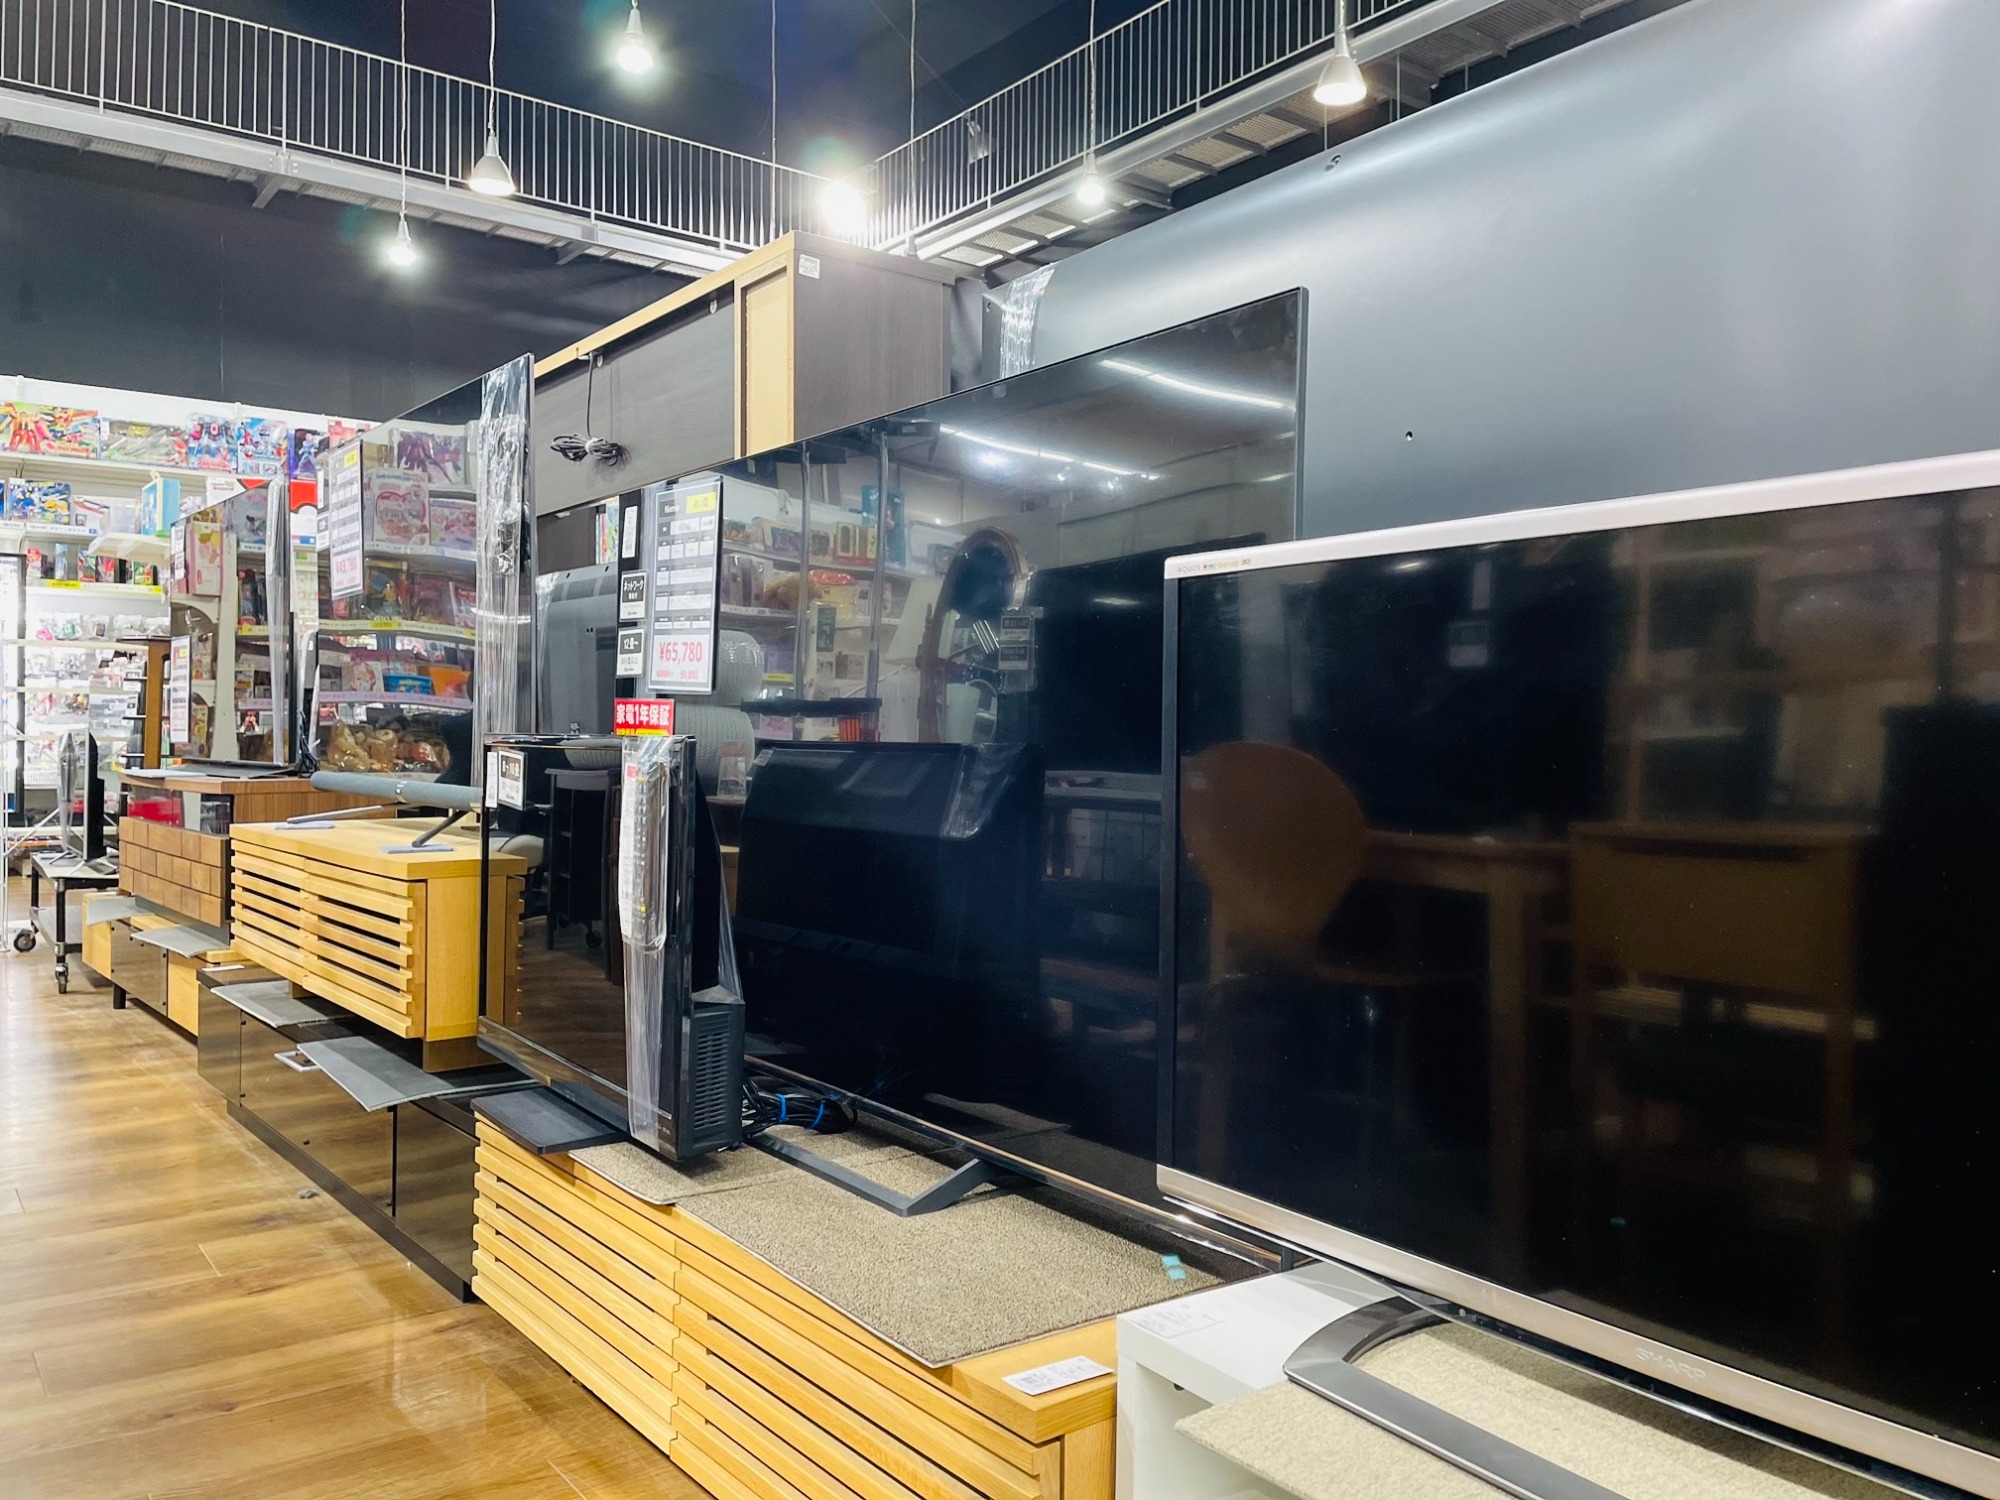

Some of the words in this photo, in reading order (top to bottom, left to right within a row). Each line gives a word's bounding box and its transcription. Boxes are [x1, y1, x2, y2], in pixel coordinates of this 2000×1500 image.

[1178, 564, 1200, 574] AQUOS
[623, 578, 644, 592] ネットワーク
[659, 641, 703, 664] ¥65,780
[616, 703, 671, 726] 家電1年保証
[1635, 1347, 1707, 1379] SHARP
